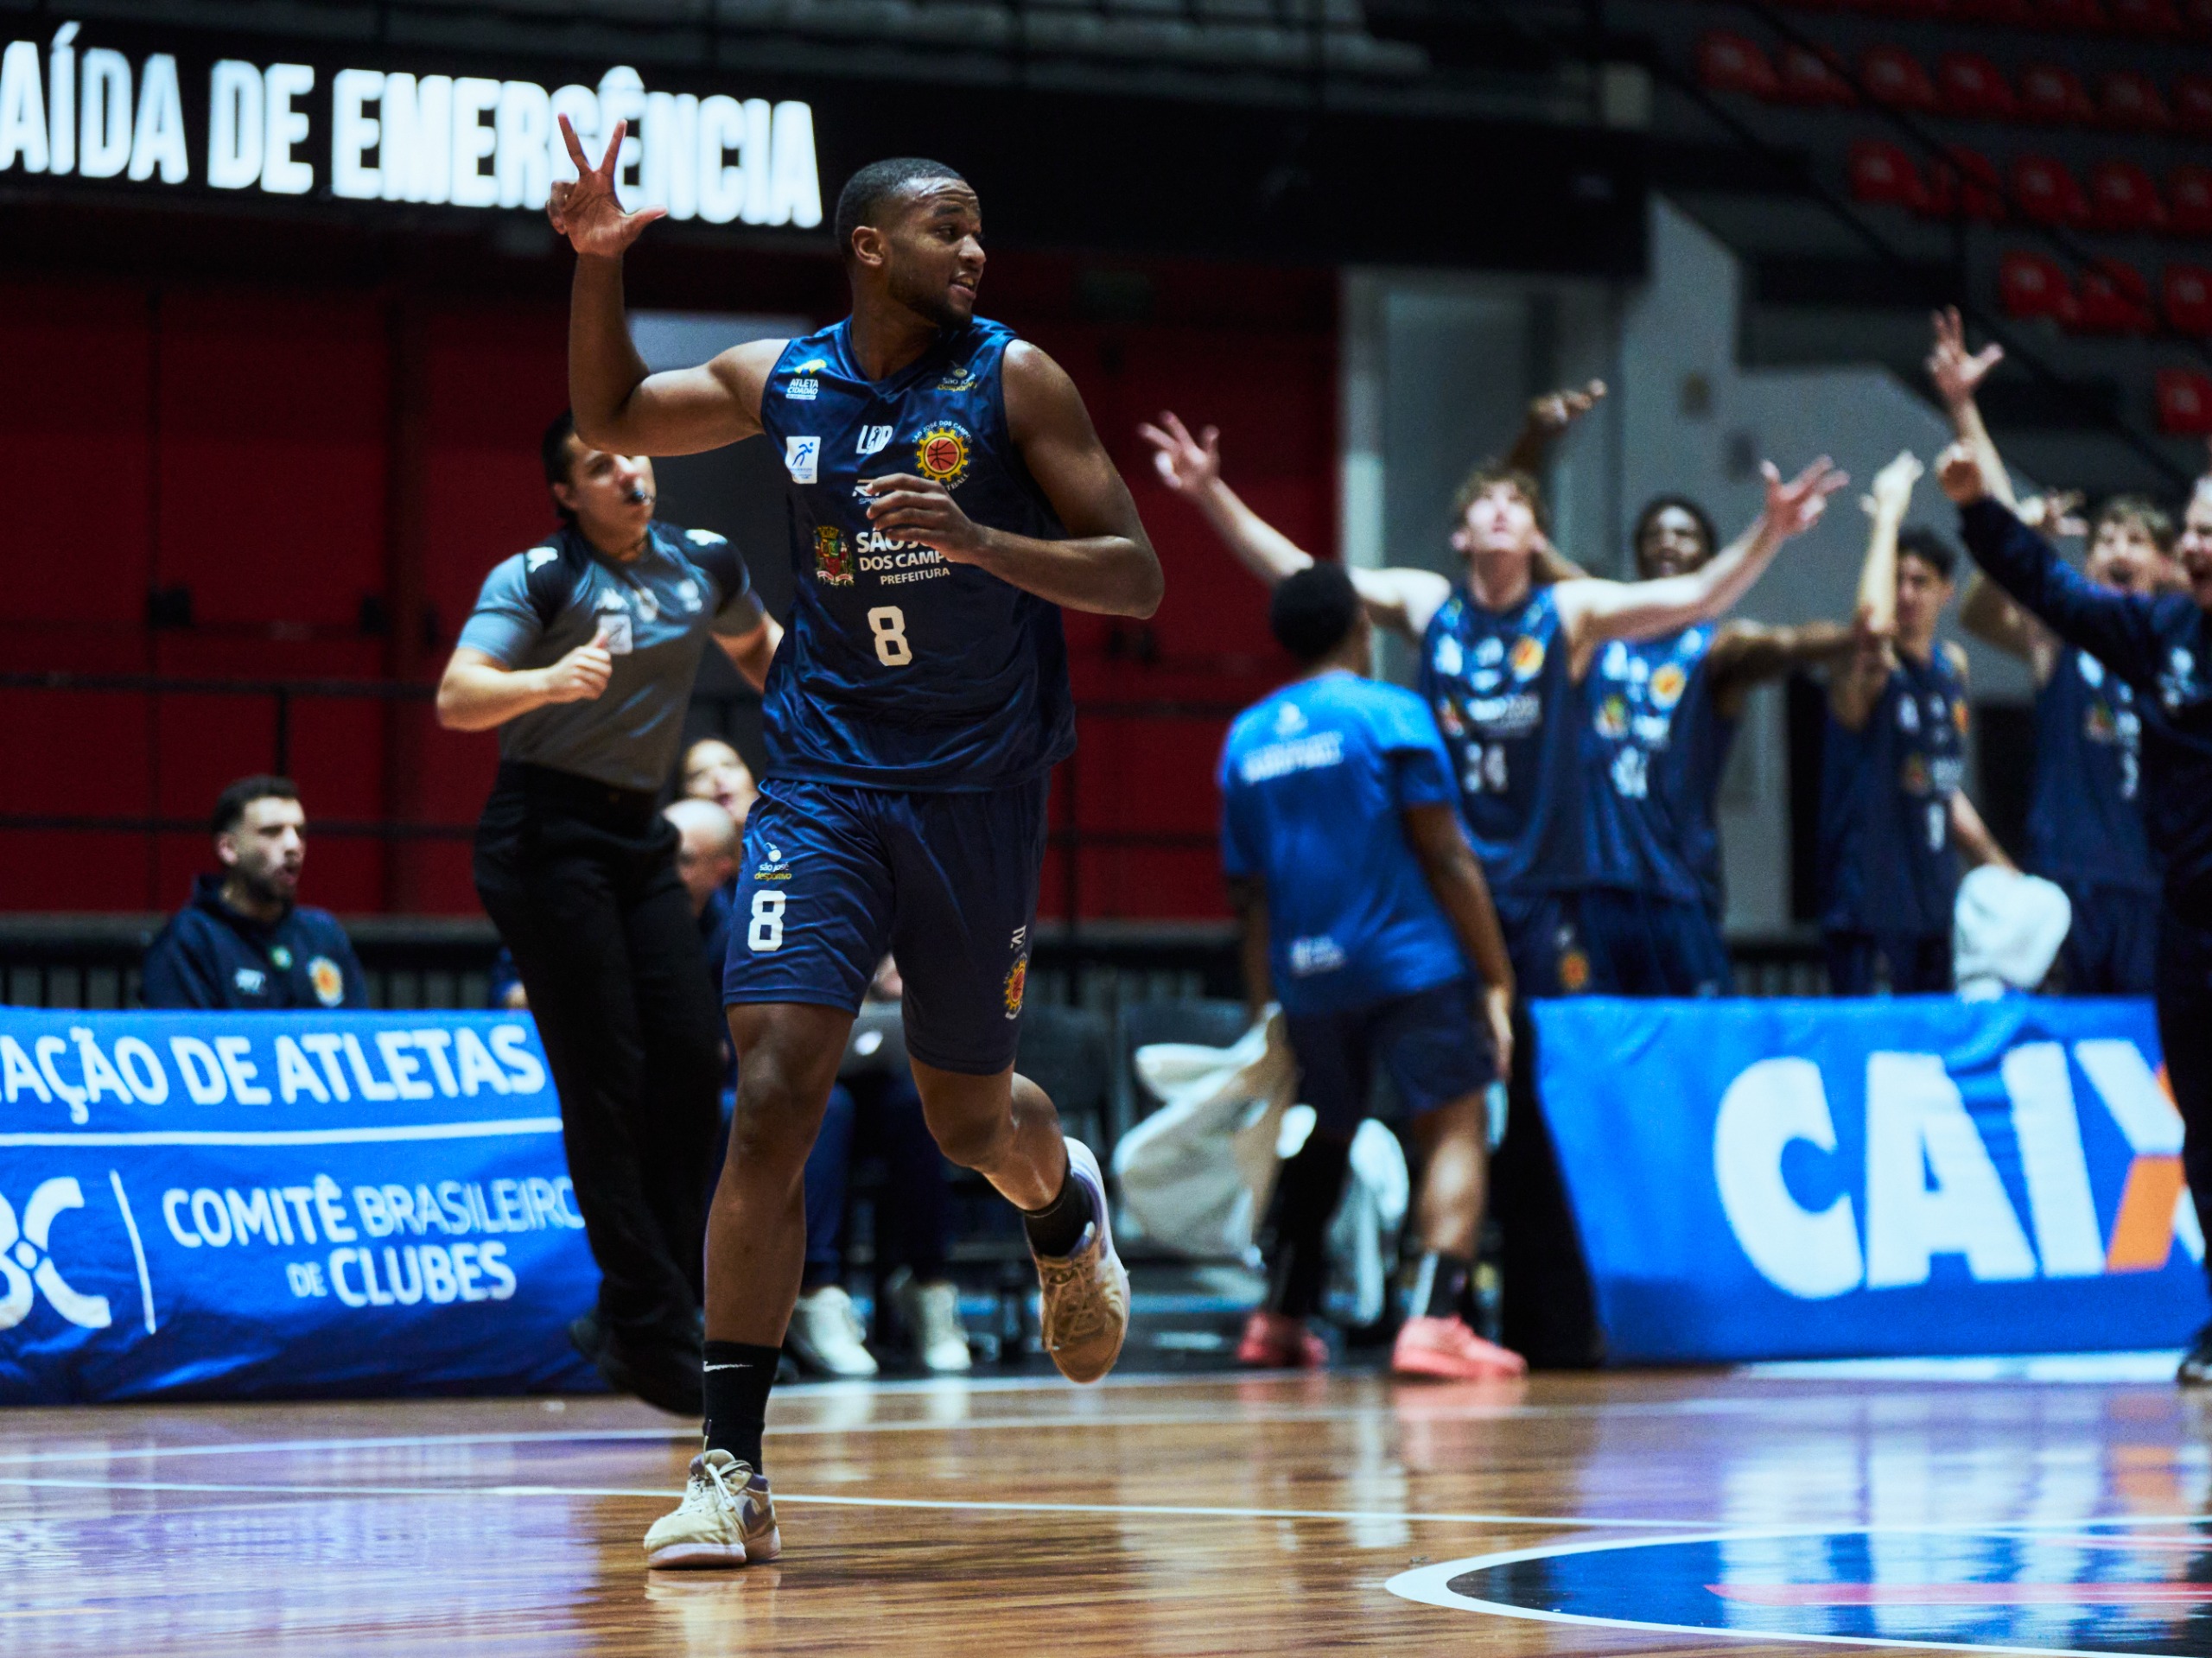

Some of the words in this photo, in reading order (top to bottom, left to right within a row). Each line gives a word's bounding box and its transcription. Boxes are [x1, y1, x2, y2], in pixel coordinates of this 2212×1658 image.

[0, 21, 188, 184] AÍDA
[207, 59, 315, 195] DE
[332, 65, 823, 228] EMERGÊNCIA
[790, 378, 818, 388] ATLETA
[953, 422, 973, 443] CAMPOS
[859, 555, 893, 571] DOS
[895, 550, 954, 568] CAMP
[880, 567, 950, 585] PREFEITURA
[867, 605, 912, 666] 8
[747, 890, 787, 951] 8
[0, 1026, 169, 1125] AÇÃO
[170, 1036, 271, 1105] DE
[276, 1025, 546, 1103] ATLETAS
[162, 1173, 356, 1248] COMITÊ
[286, 1262, 327, 1298] DE
[329, 1241, 516, 1307] CLUBES
